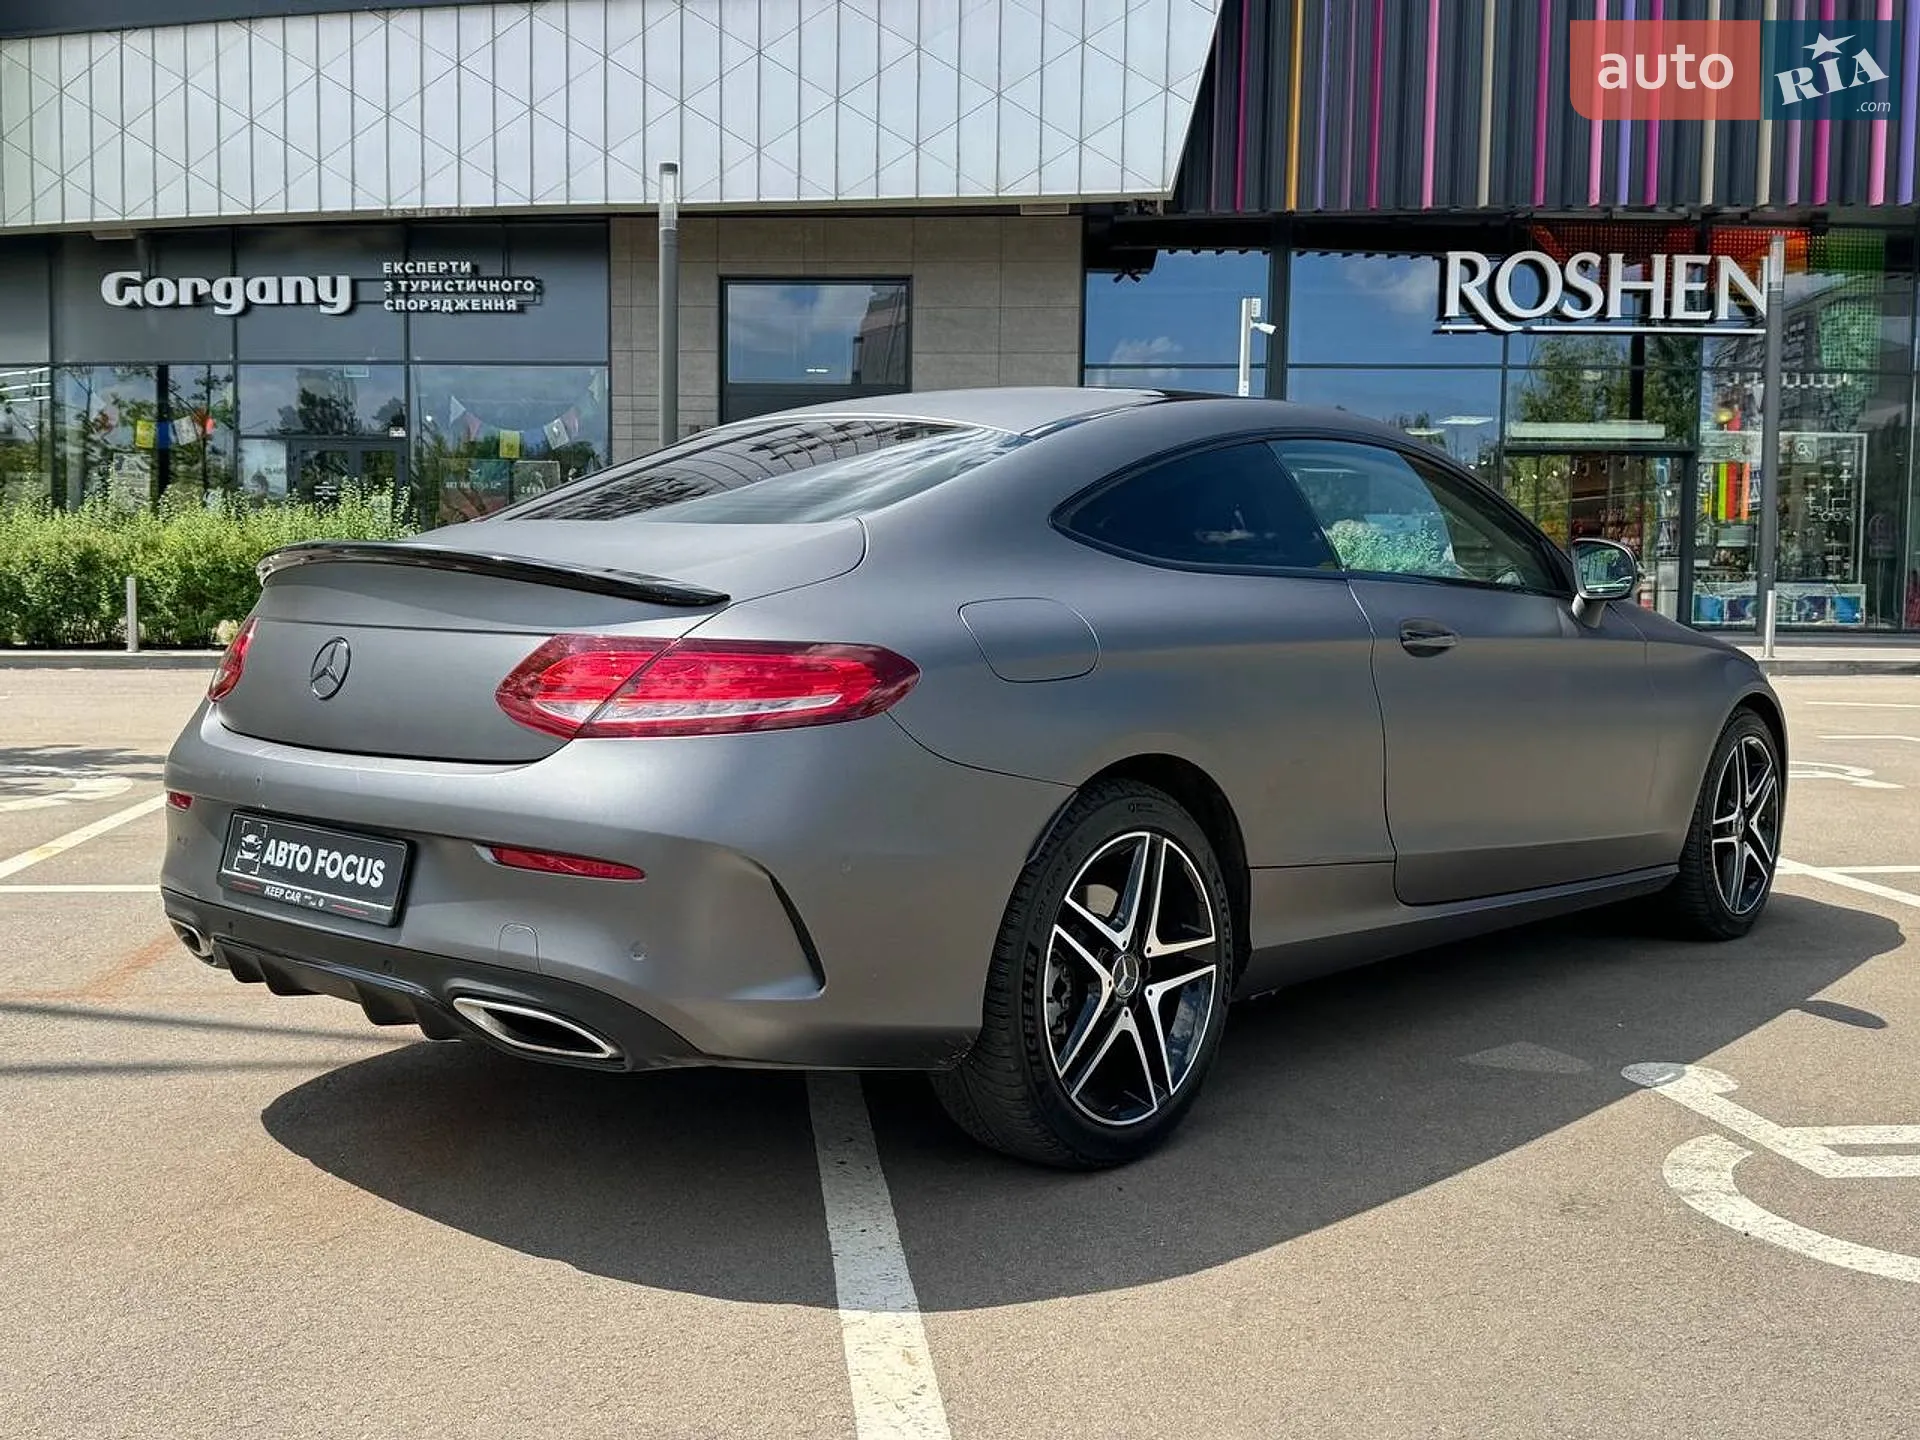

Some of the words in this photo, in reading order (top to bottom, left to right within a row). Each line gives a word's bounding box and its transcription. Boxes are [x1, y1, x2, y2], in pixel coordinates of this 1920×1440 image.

[382, 261, 472, 274] ЕКСПЕРТИ
[101, 270, 352, 315] Gorgany
[398, 280, 536, 293] ТУРИСТИЧНОГО
[1444, 250, 1770, 332] ROSHEN
[383, 299, 518, 313] СПОРЯДЖЕННЯ
[262, 838, 312, 873] АВТО
[313, 848, 386, 888] FOCUS
[264, 885, 285, 899] KEEP
[285, 889, 301, 904] CAR
